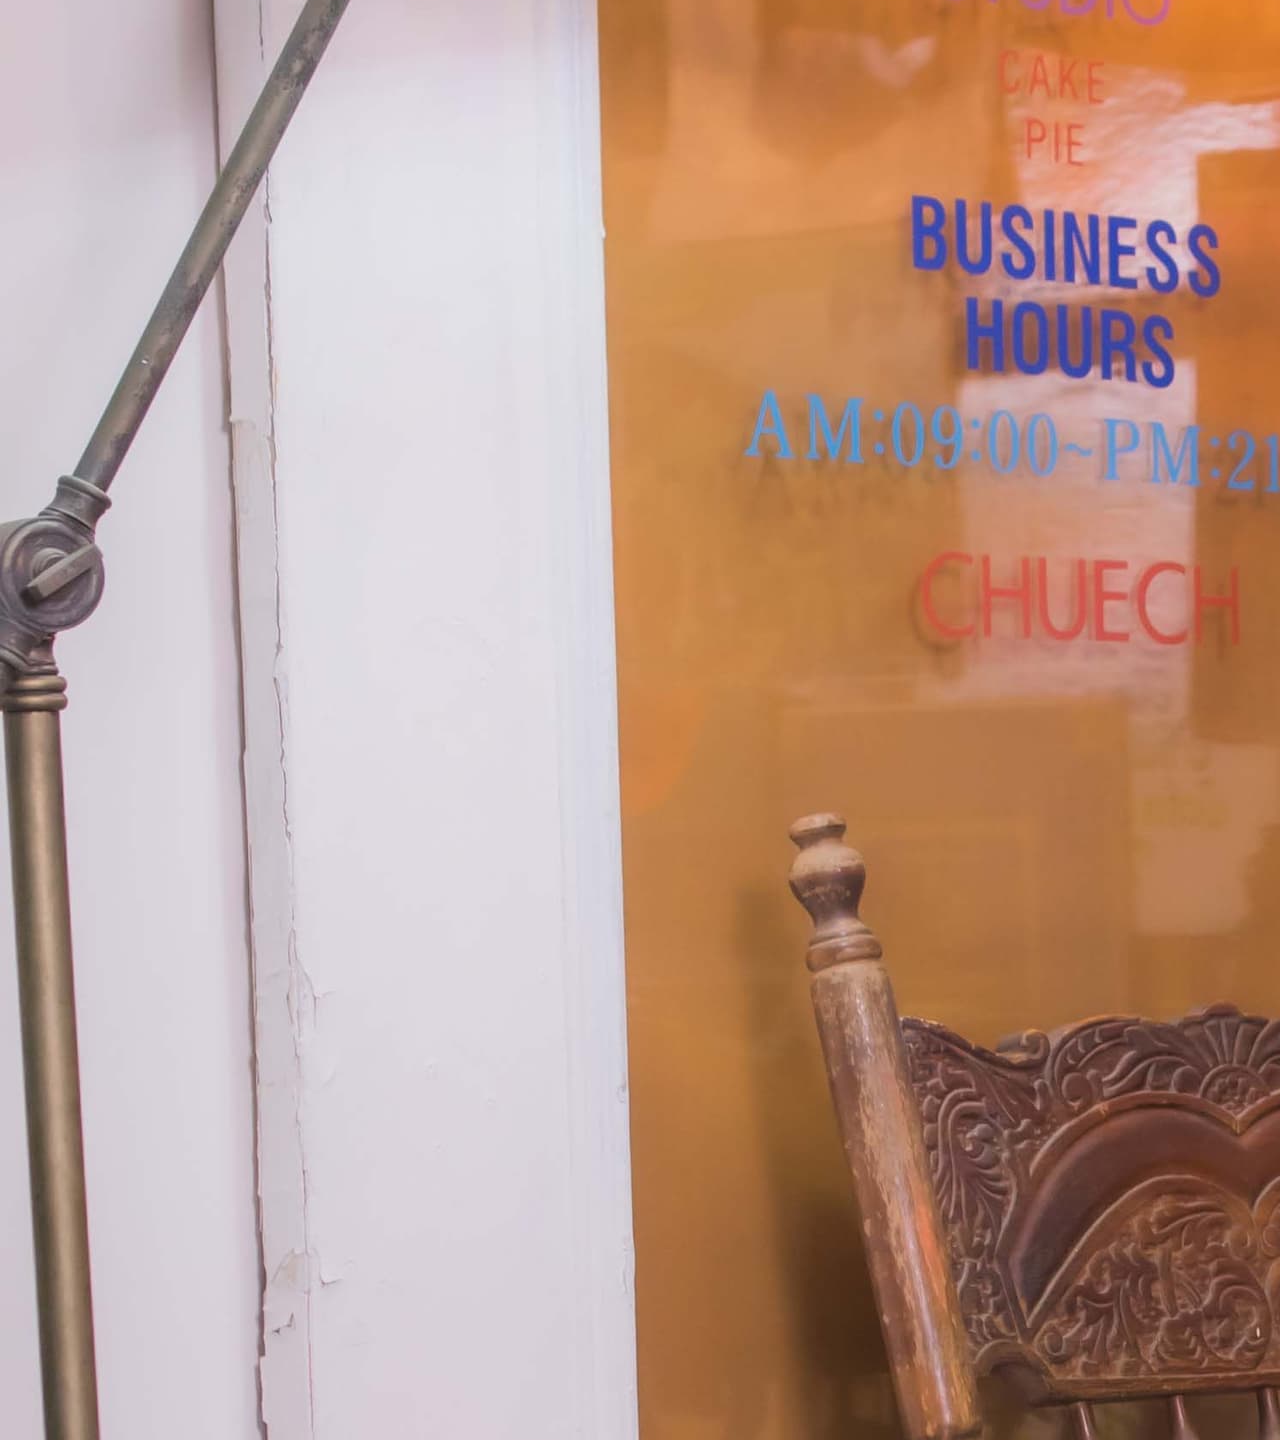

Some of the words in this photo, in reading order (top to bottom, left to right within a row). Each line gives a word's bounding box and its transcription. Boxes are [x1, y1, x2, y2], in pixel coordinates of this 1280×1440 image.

[1000, 50, 1107, 107] CAKE
[1024, 117, 1087, 168] PIE
[911, 194, 1223, 299] BUSINESS
[965, 296, 1176, 389] HOURS
[919, 550, 1242, 647] CHUECH
